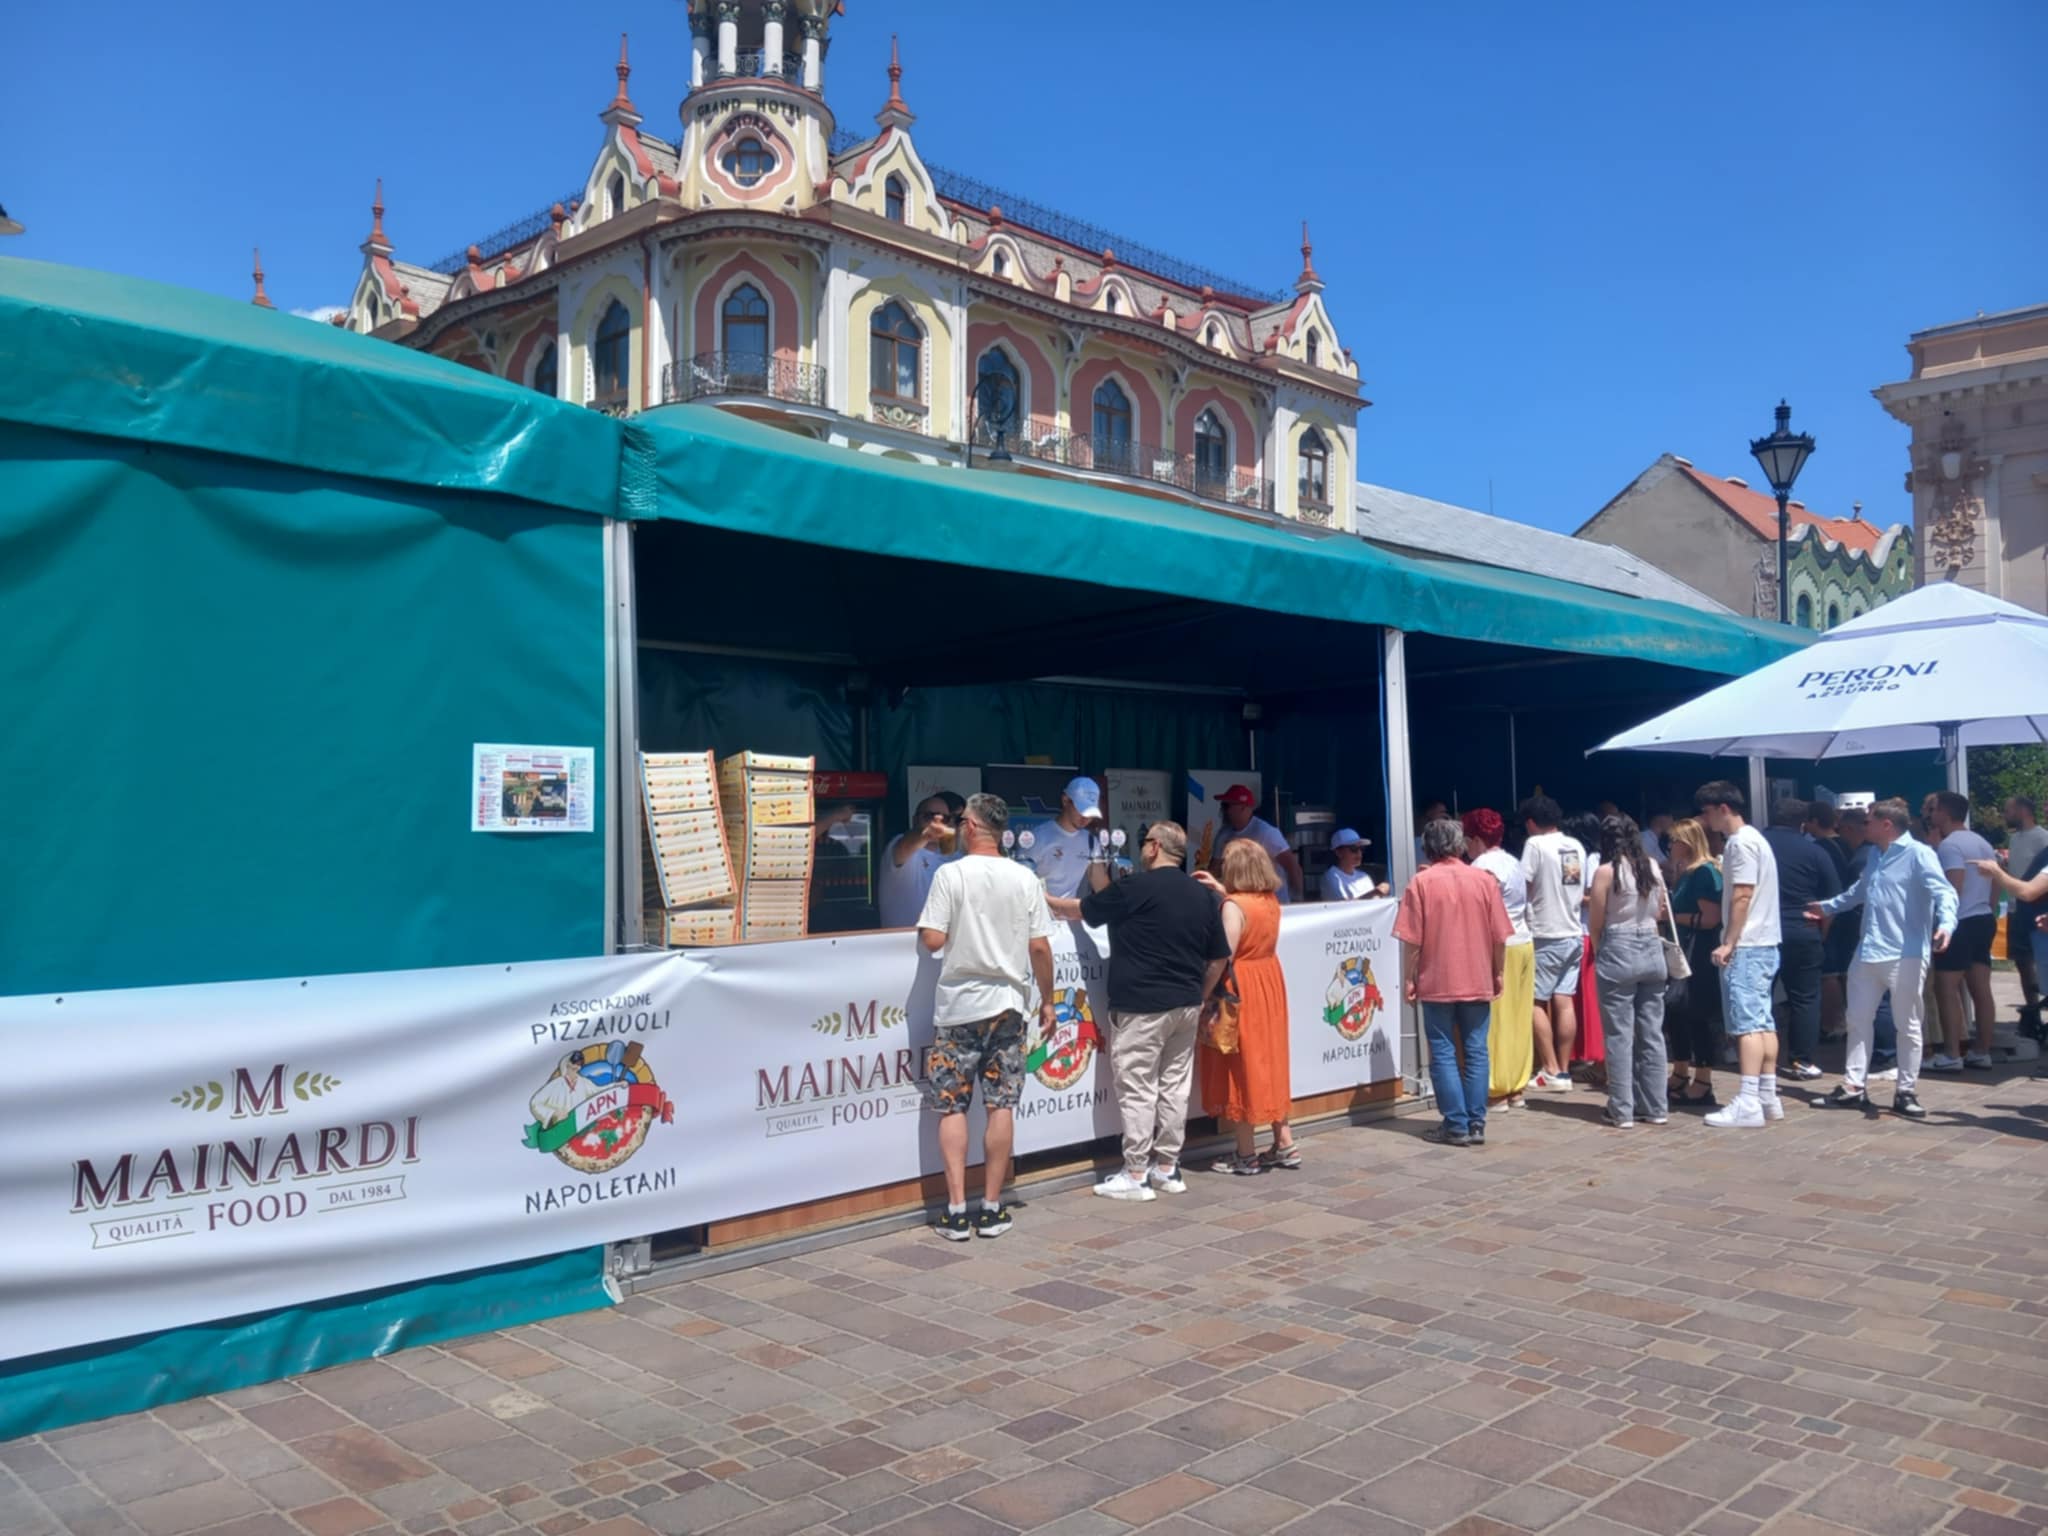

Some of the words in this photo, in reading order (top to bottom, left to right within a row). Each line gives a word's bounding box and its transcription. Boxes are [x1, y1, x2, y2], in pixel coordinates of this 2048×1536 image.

[697, 98, 740, 117] GRAND
[756, 98, 801, 120] HOTEL
[1798, 660, 1938, 688] PERONI
[1806, 683, 1900, 699] AZZURRO
[1325, 938, 1381, 957] PIZZAIUOLI
[550, 993, 652, 1017] ASSOCIAZIONE
[531, 1010, 671, 1044] PIZZAIUOLI
[845, 1000, 879, 1041] M
[1322, 1041, 1385, 1064] NAPOLETANI
[230, 1063, 289, 1119] M
[585, 1091, 617, 1121] APN
[1015, 1088, 1107, 1120] NAPOLETANI
[832, 1097, 889, 1126] FOOD
[70, 1116, 422, 1213] MAINARDI
[526, 1168, 676, 1213] NAPOLETANI
[109, 1213, 184, 1241] QUALITÀ
[207, 1191, 308, 1231] FOOD
[329, 1189, 355, 1204] DAL
[360, 1184, 392, 1199] 1984
